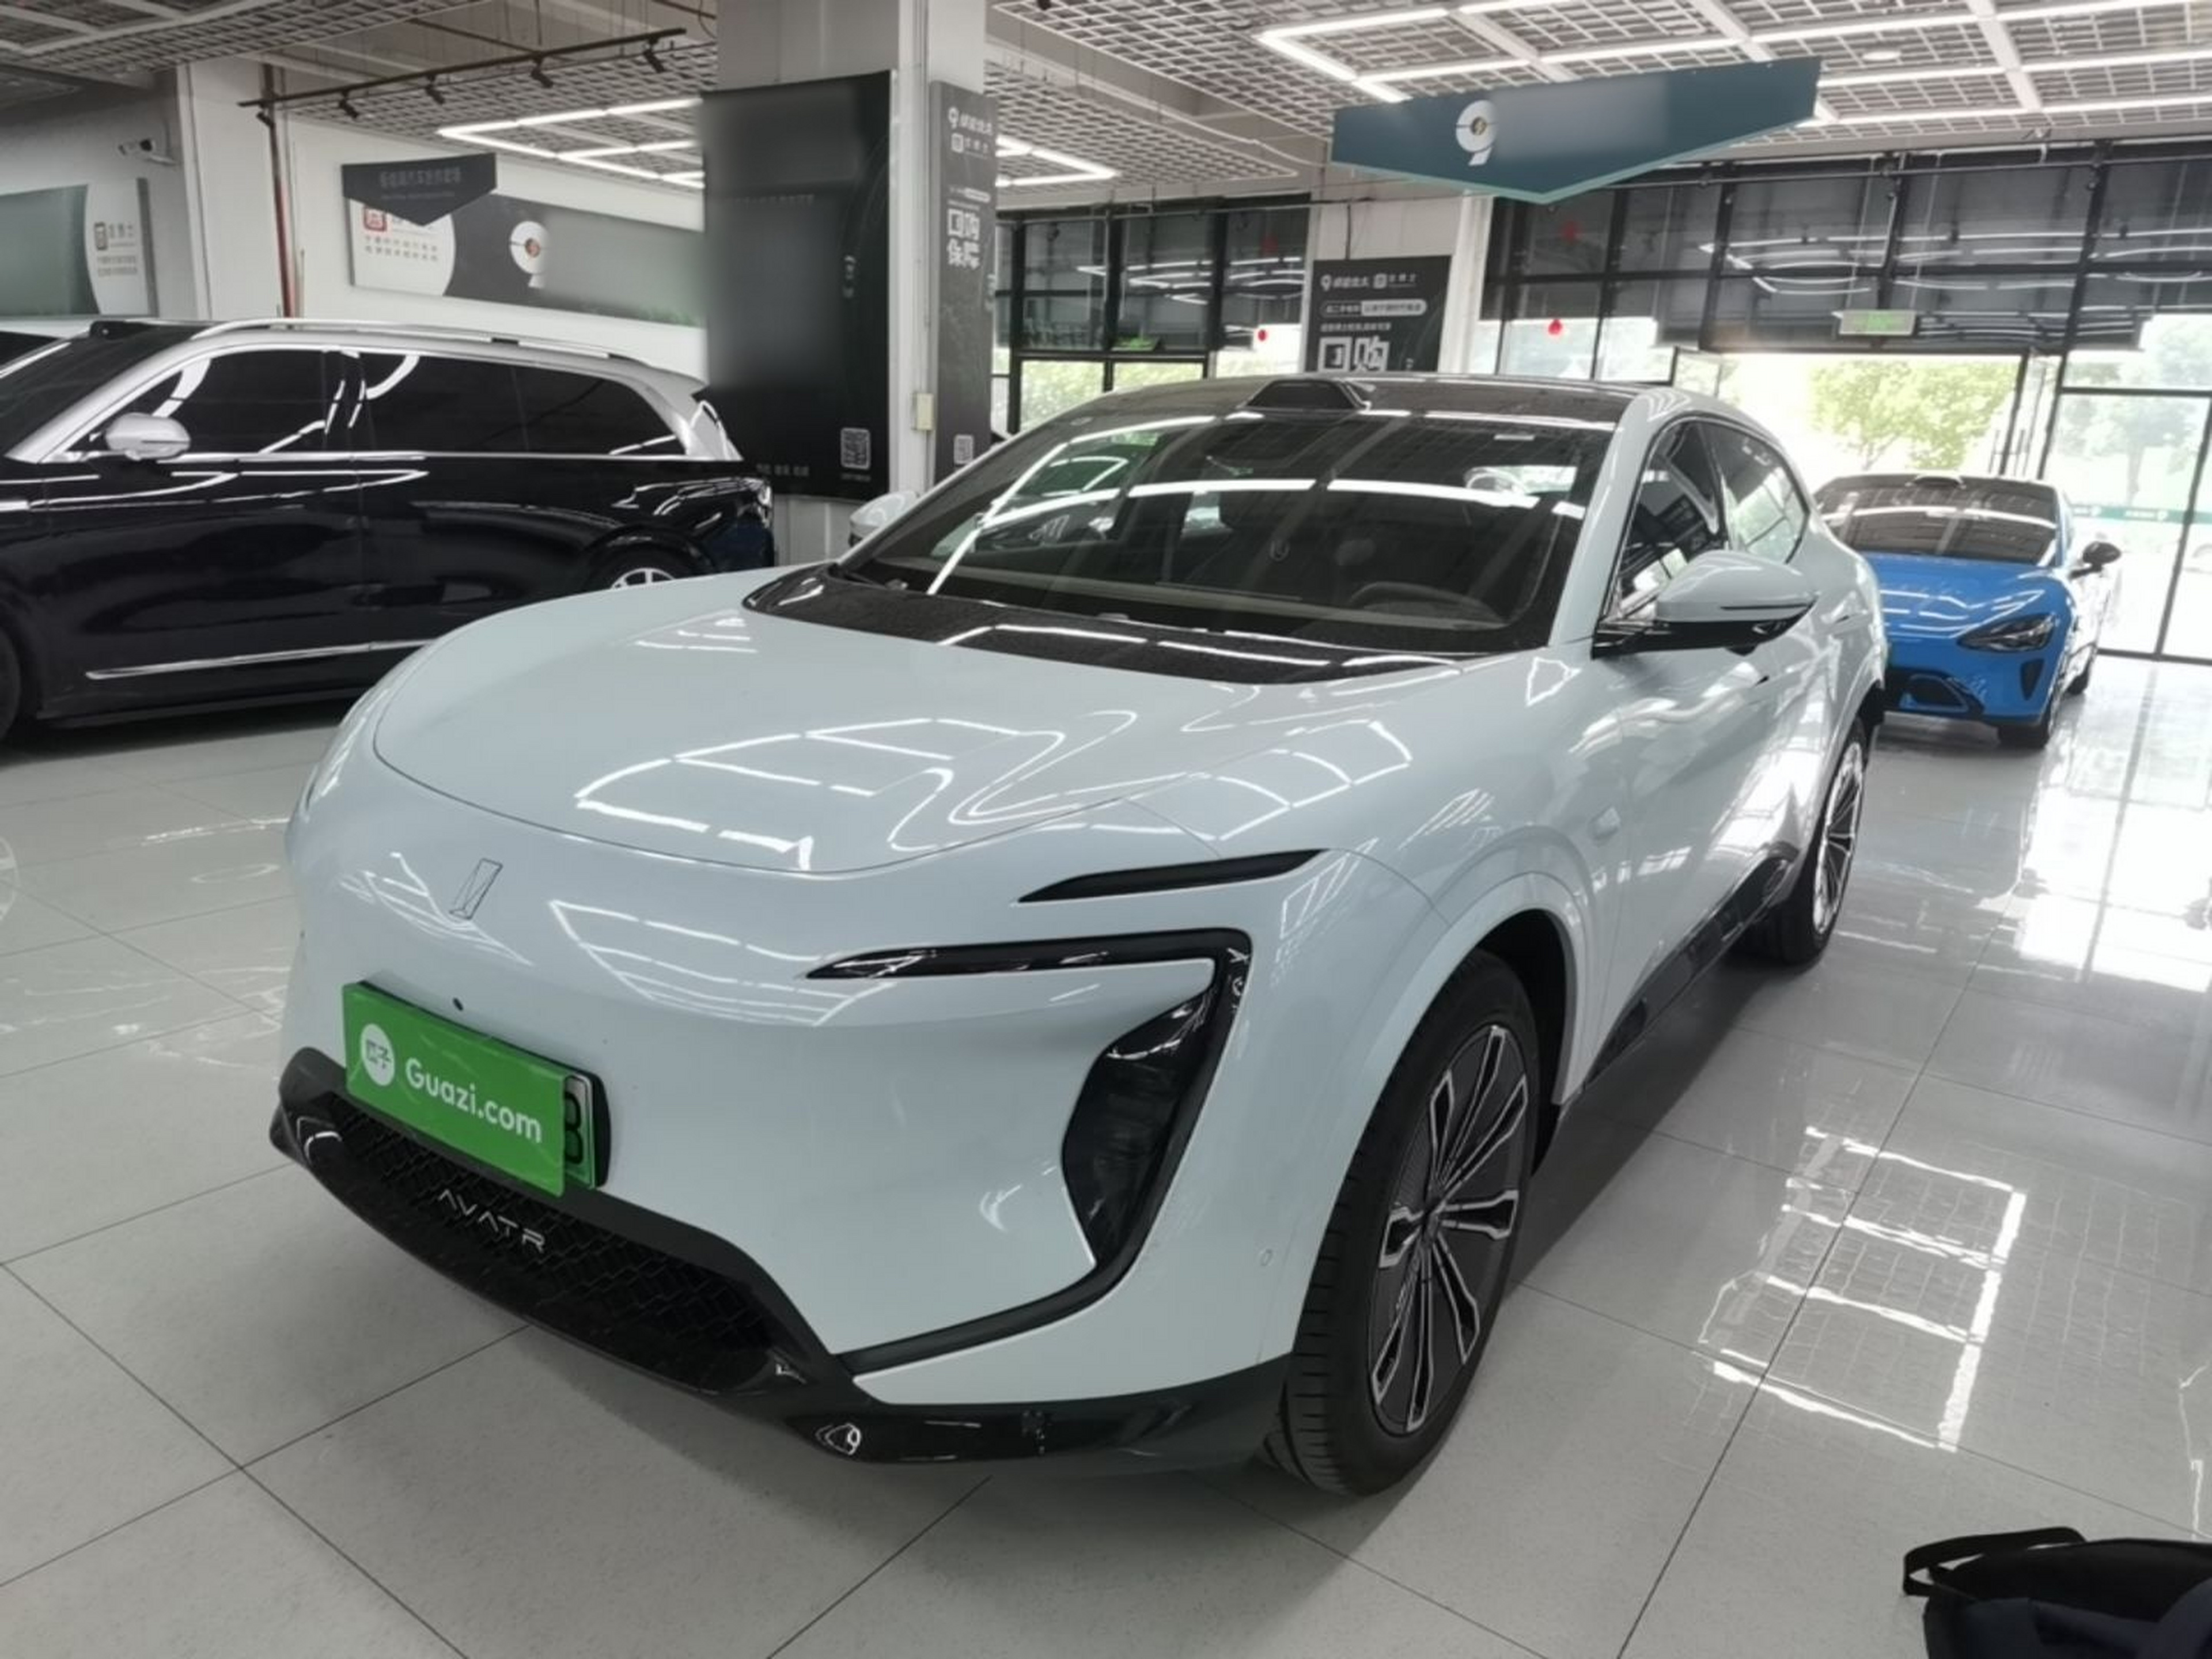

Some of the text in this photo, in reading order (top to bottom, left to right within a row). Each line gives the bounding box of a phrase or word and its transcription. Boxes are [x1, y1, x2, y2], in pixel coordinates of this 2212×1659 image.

[947, 209, 980, 241] 回购
[946, 238, 981, 271] 保障
[1317, 335, 1389, 372] 回购
[405, 1058, 542, 1143] Guazi.com
[438, 1188, 546, 1254] AVATR
